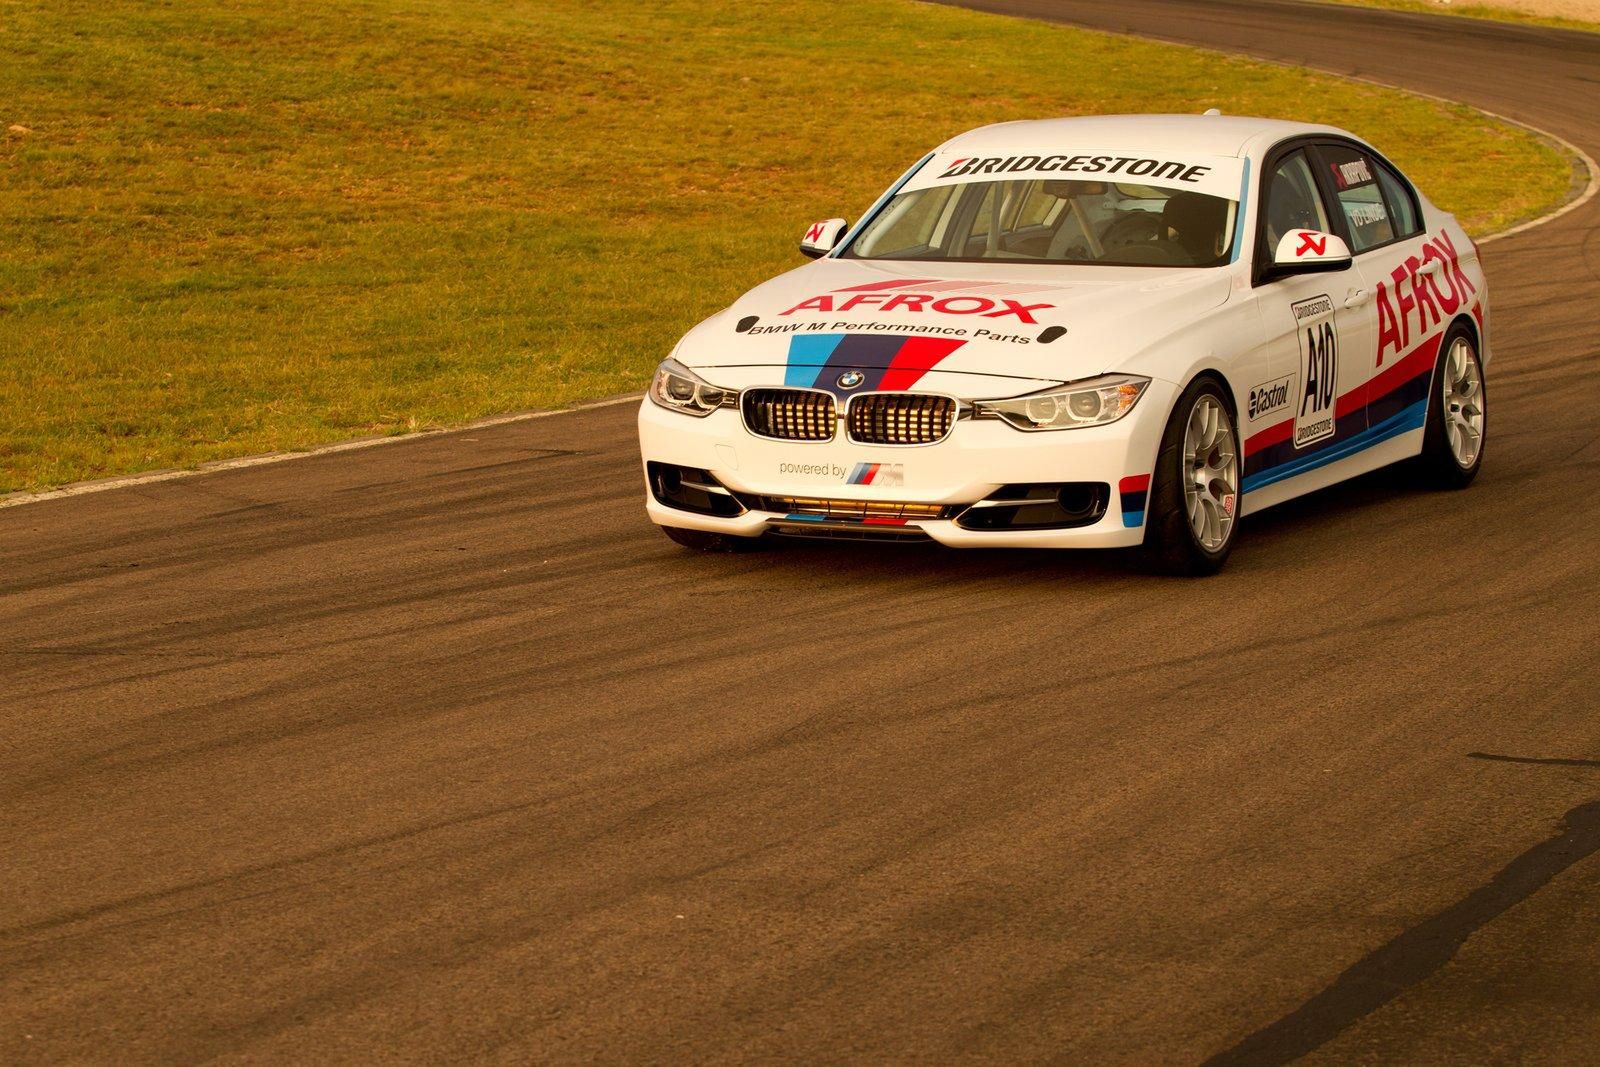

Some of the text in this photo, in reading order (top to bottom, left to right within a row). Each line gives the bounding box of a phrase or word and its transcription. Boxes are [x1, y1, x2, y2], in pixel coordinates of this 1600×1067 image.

[936, 155, 1212, 183] BRIDGESTONE
[777, 294, 1057, 325] AFROX
[1295, 299, 1332, 320] BRIDGESTONE
[1376, 228, 1477, 368] AFROX
[748, 321, 1031, 345] BMW M Performance Parts
[1300, 321, 1336, 417] A10
[1255, 380, 1290, 415] Castrol
[1297, 417, 1332, 442] BRIDGESTONE
[780, 462, 829, 475] powered
[832, 463, 847, 479] by
